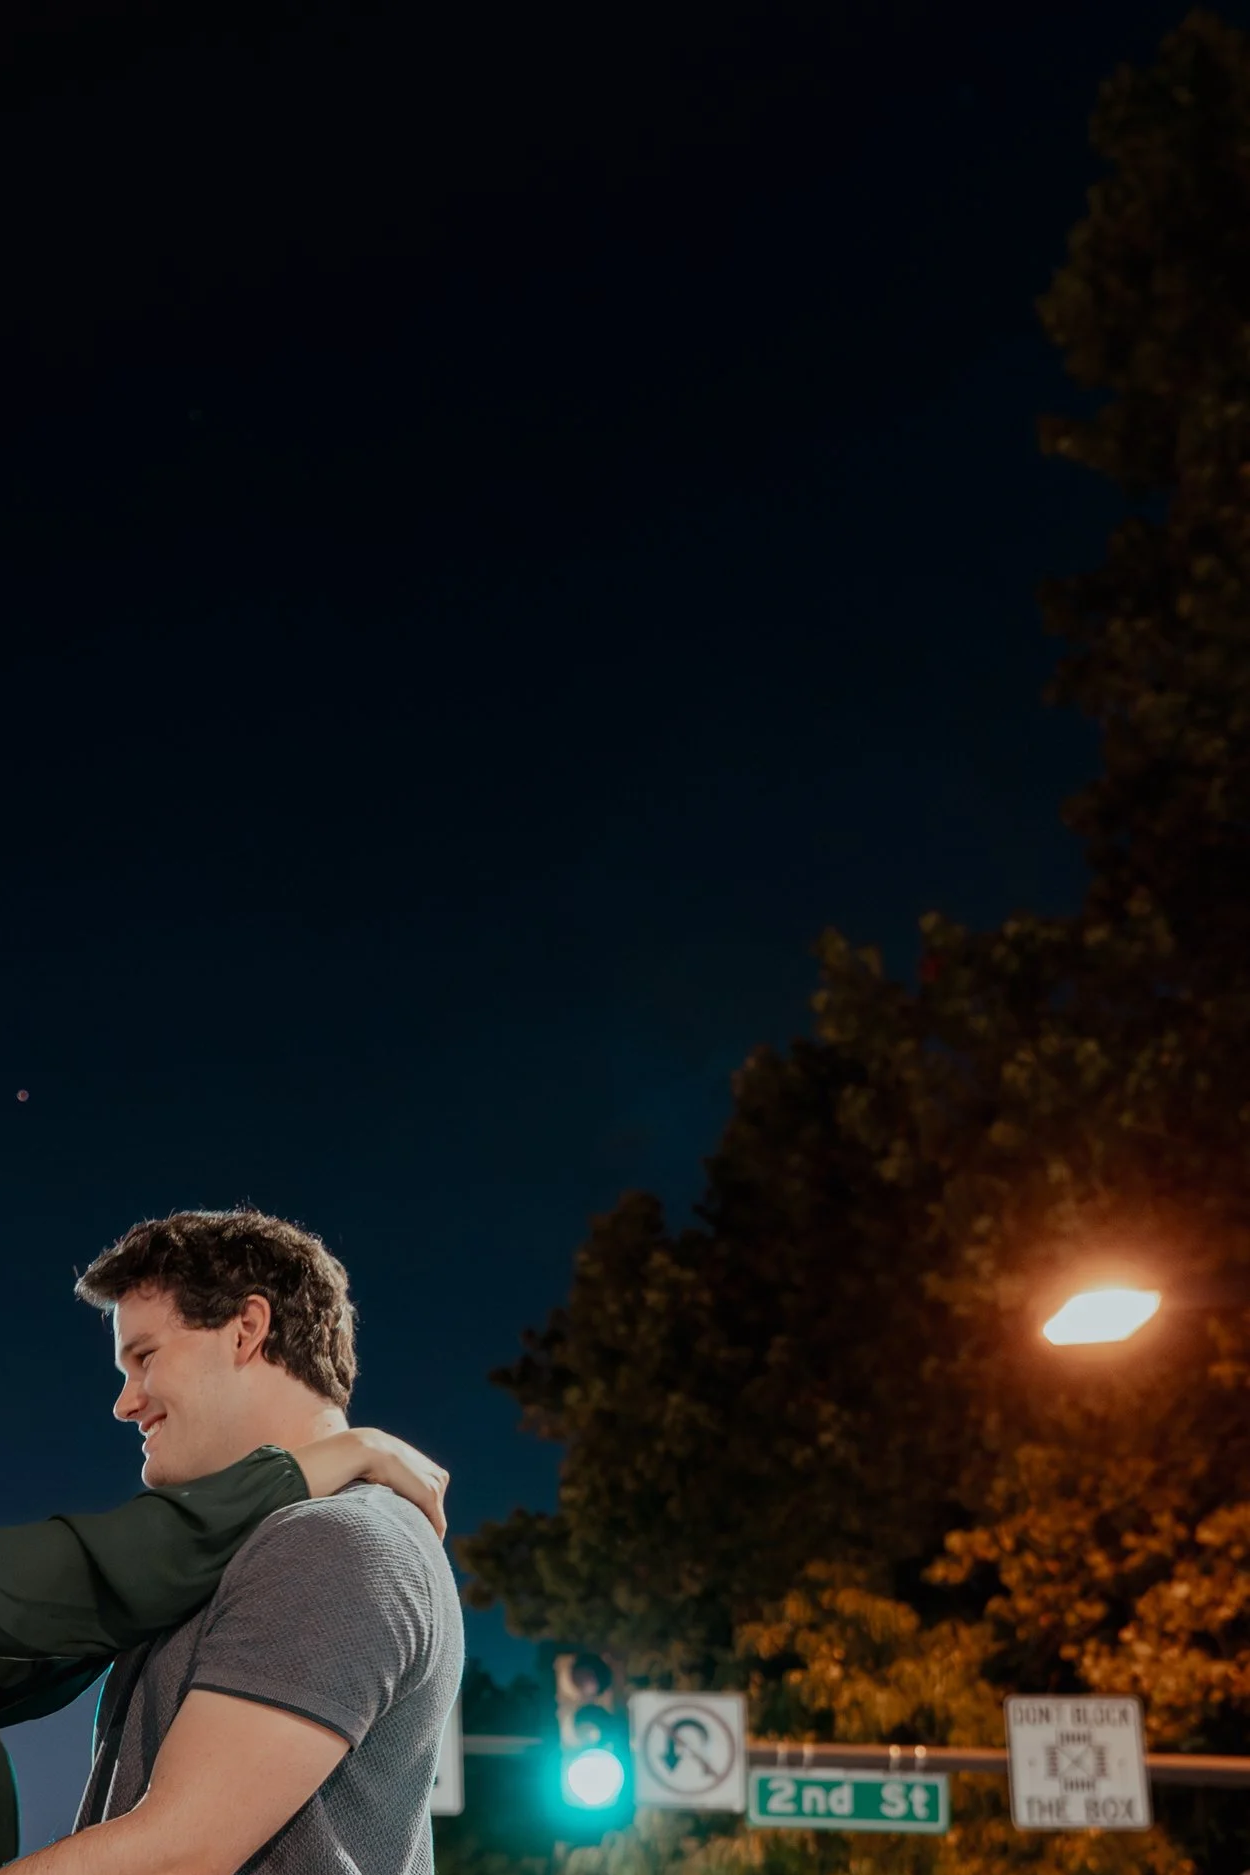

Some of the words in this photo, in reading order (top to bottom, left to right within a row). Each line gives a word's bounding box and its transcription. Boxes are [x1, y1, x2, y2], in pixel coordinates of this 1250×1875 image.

[1071, 1704, 1130, 1728] BLOCK
[766, 1778, 854, 1816] 2nd
[880, 1782, 930, 1819] St
[1025, 1797, 1068, 1823] THE
[1084, 1798, 1137, 1824] BOX
